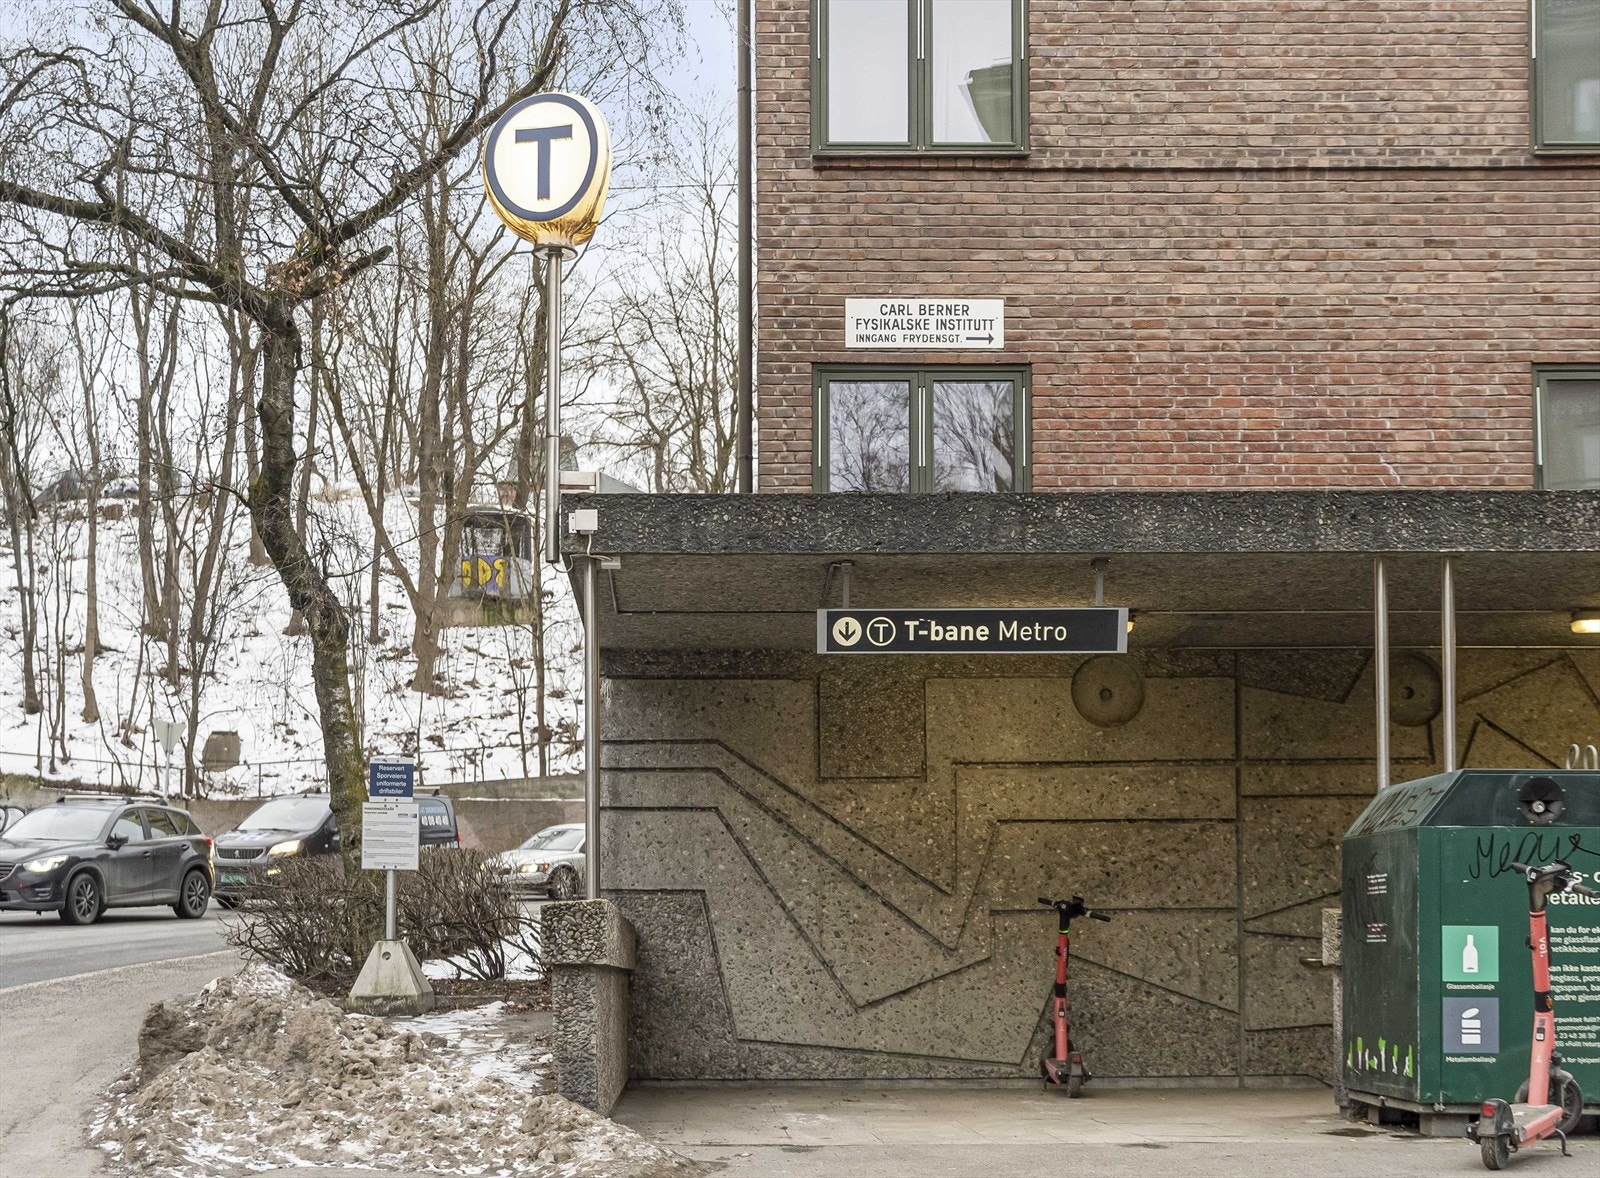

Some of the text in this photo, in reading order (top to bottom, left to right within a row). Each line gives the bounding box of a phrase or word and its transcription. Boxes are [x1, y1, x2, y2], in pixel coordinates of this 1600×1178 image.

[515, 124, 573, 200] T
[880, 304, 970, 316] CARL BERNER
[855, 318, 995, 331] FYSIKALSKE INSTITUTT
[855, 333, 963, 344] INNGANG FRYDENSGT.
[904, 620, 990, 642] T-bane
[998, 620, 1068, 642] Metro
[376, 772, 407, 780] Sporveiens
[375, 780, 407, 788] uniformerte
[1577, 926, 1591, 934] for
